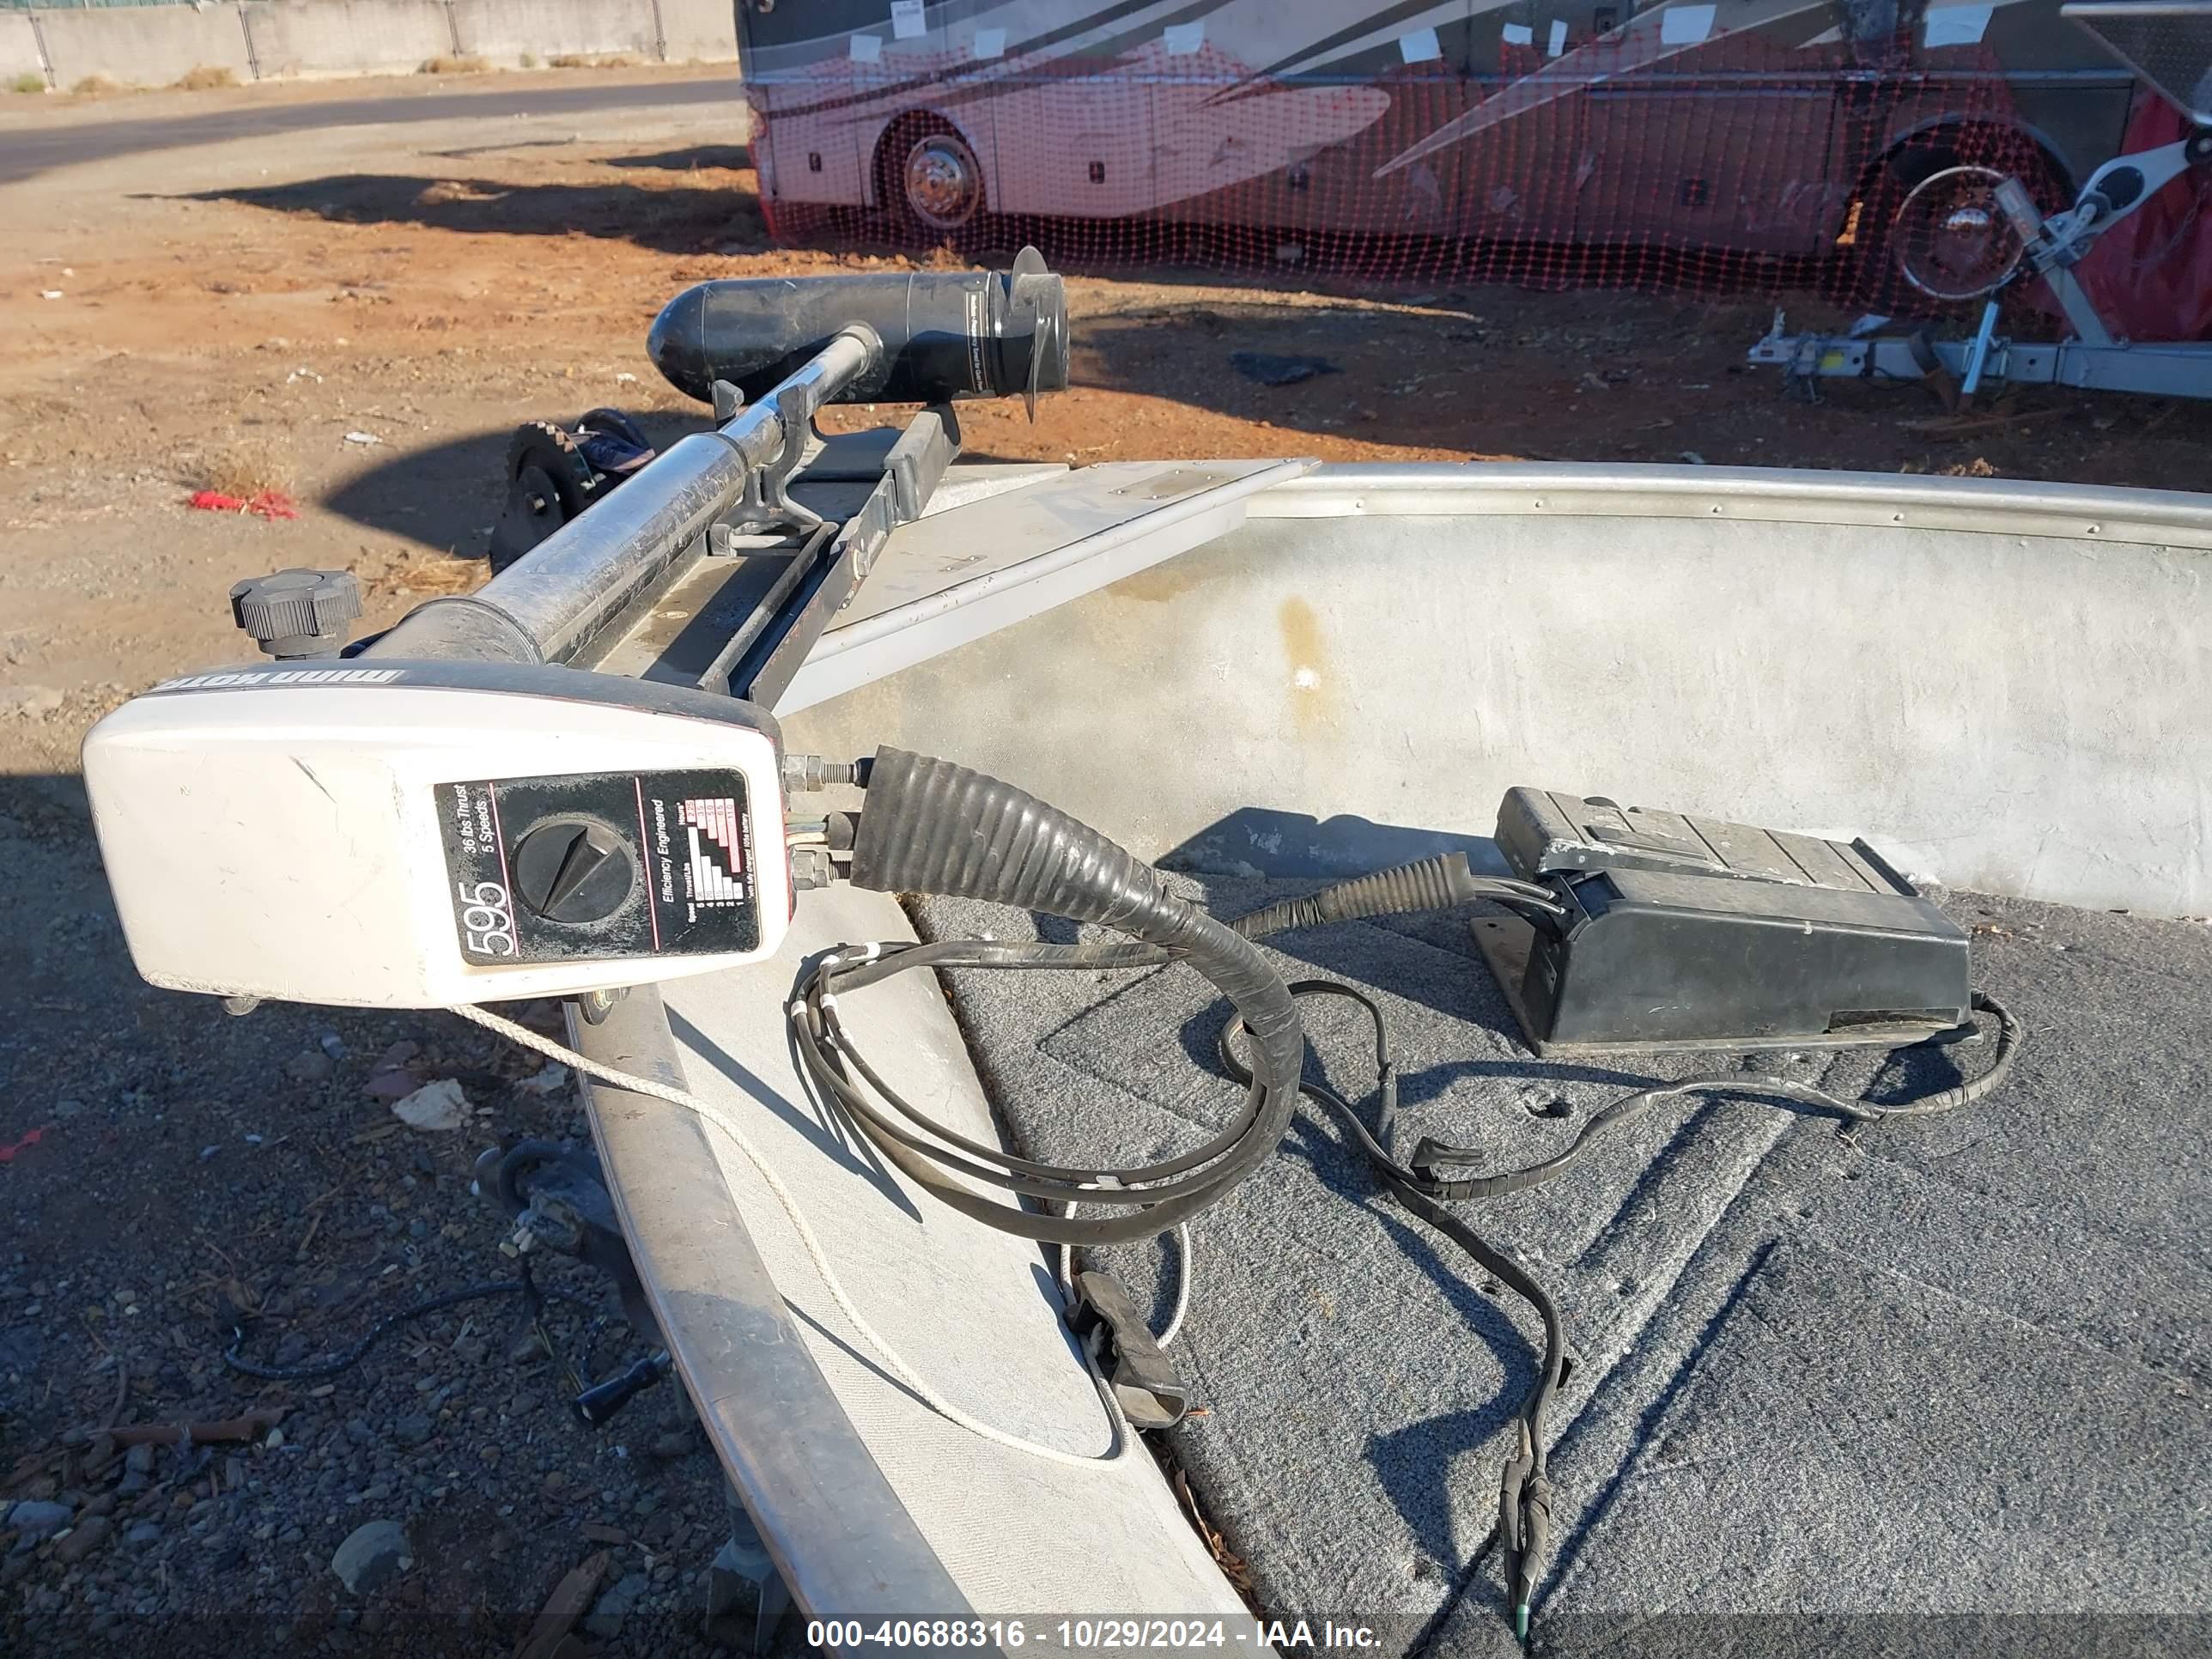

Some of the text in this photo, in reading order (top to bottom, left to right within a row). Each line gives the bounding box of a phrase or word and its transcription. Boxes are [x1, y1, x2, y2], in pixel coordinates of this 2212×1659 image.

[453, 785, 477, 854] 36 lbs Thrust
[475, 800, 495, 842] Speeds
[651, 799, 674, 902] Efficiency Engineered
[744, 848, 752, 872] charged
[684, 862, 693, 898] Thrust/Lbs
[458, 882, 514, 957] 595
[687, 902, 697, 922] Speed
